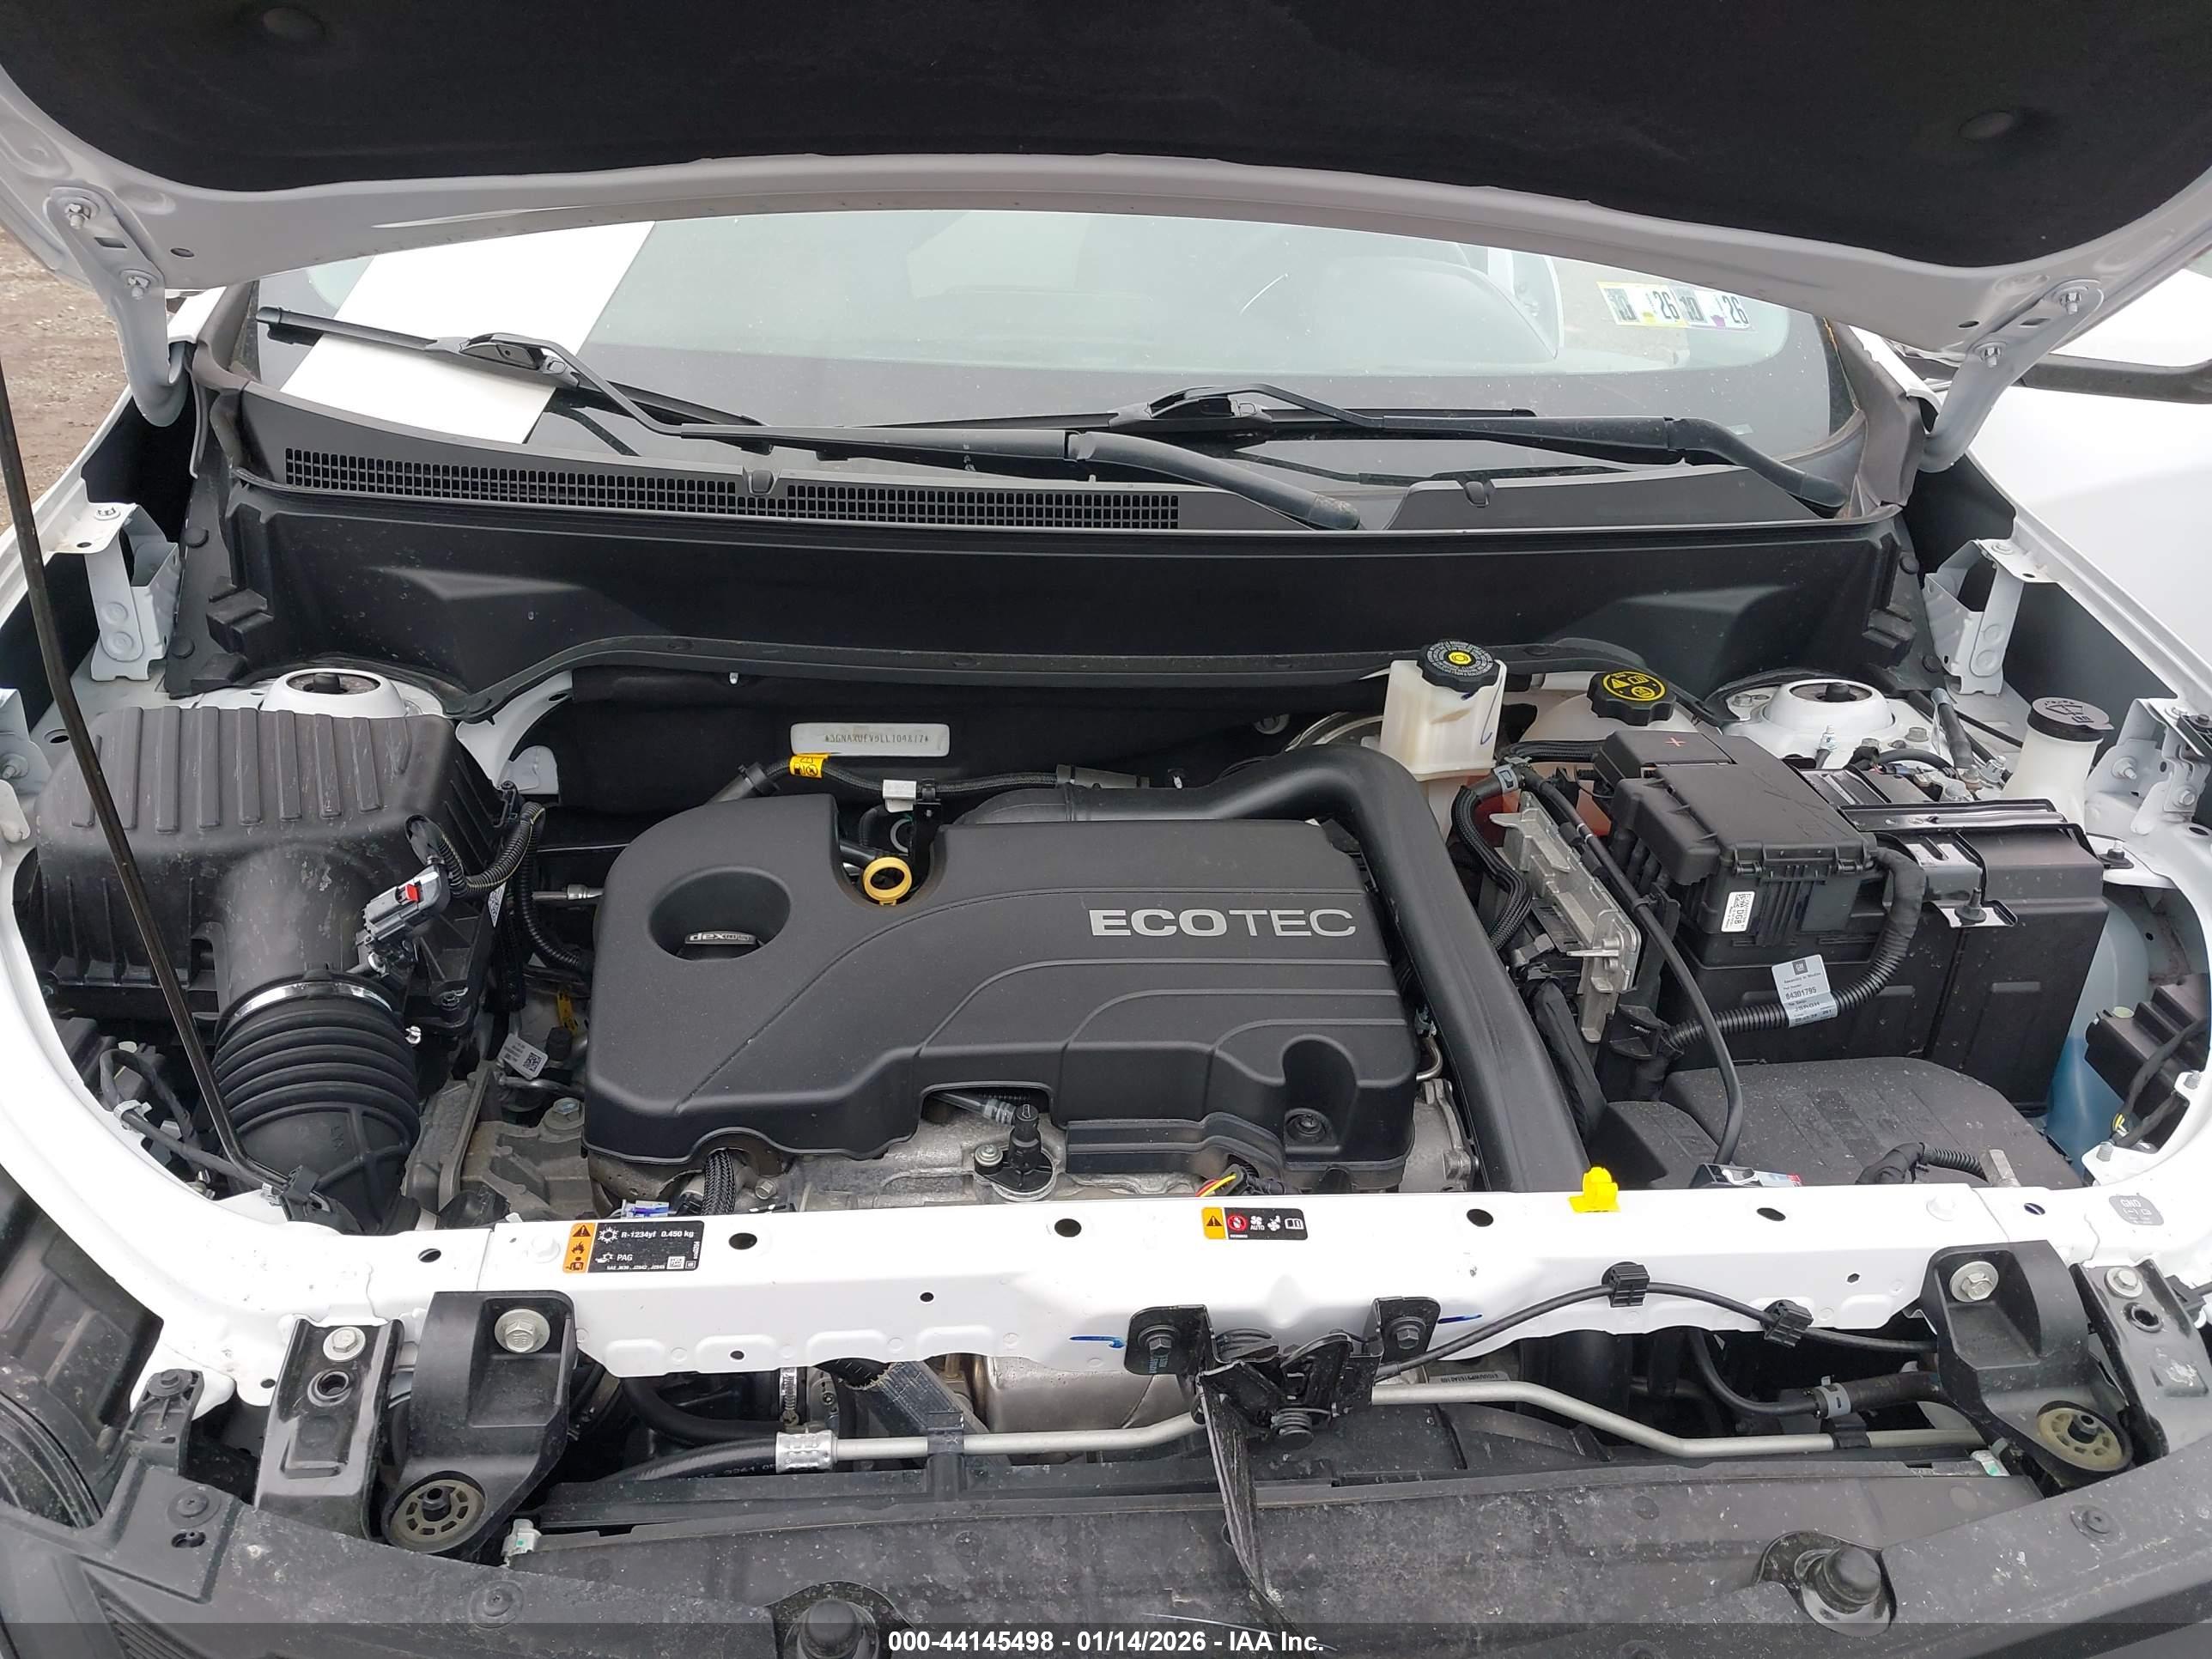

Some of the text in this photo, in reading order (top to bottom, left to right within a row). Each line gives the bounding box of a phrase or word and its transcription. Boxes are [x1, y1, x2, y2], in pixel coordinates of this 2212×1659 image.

[1653, 291, 1680, 320] 26
[1722, 295, 1749, 325] 26
[690, 933, 750, 941] dexos
[1089, 908, 1357, 937] ECOTEC
[621, 1231, 656, 1239] R-1234yf
[684, 1230, 695, 1238] kg
